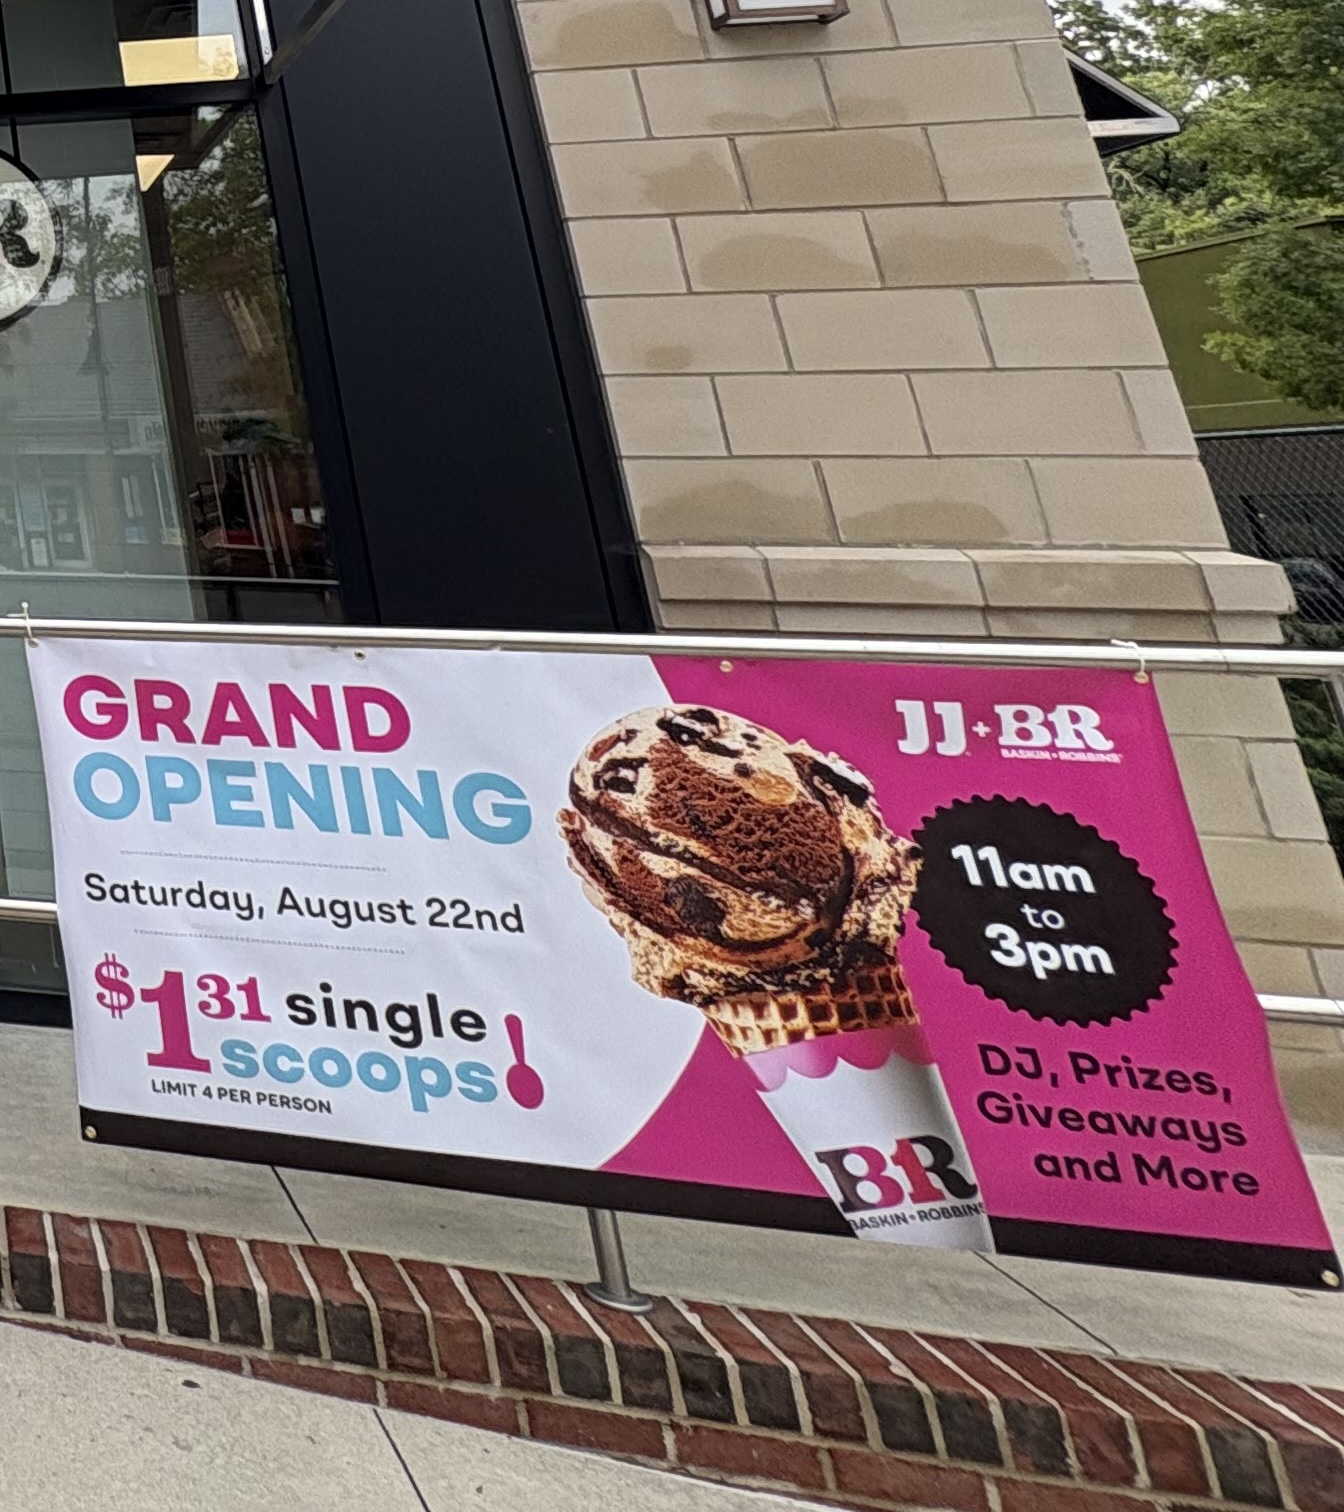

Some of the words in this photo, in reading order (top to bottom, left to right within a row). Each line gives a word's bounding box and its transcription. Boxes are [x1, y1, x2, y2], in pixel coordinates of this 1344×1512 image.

[63, 674, 411, 754] GRAND
[73, 751, 532, 845] OPENING
[951, 844, 1096, 893] 11am
[83, 872, 266, 921] Saturday,
[277, 887, 417, 930] August
[427, 896, 526, 934] 22nd
[1020, 902, 1065, 930] to
[984, 923, 1115, 980] 3pm
[285, 982, 488, 1048] single
[151, 1078, 198, 1099] LIMIT
[201, 1085, 213, 1100] 4
[217, 1088, 253, 1107] PER
[256, 1091, 333, 1114] PERSON
[977, 1042, 1060, 1088] DJ,
[1068, 1050, 1233, 1104] Prizes,
[977, 1091, 1247, 1153] Giveaways
[815, 1135, 978, 1214] BR
[1033, 1149, 1121, 1185] and
[1135, 1154, 1260, 1197] More
